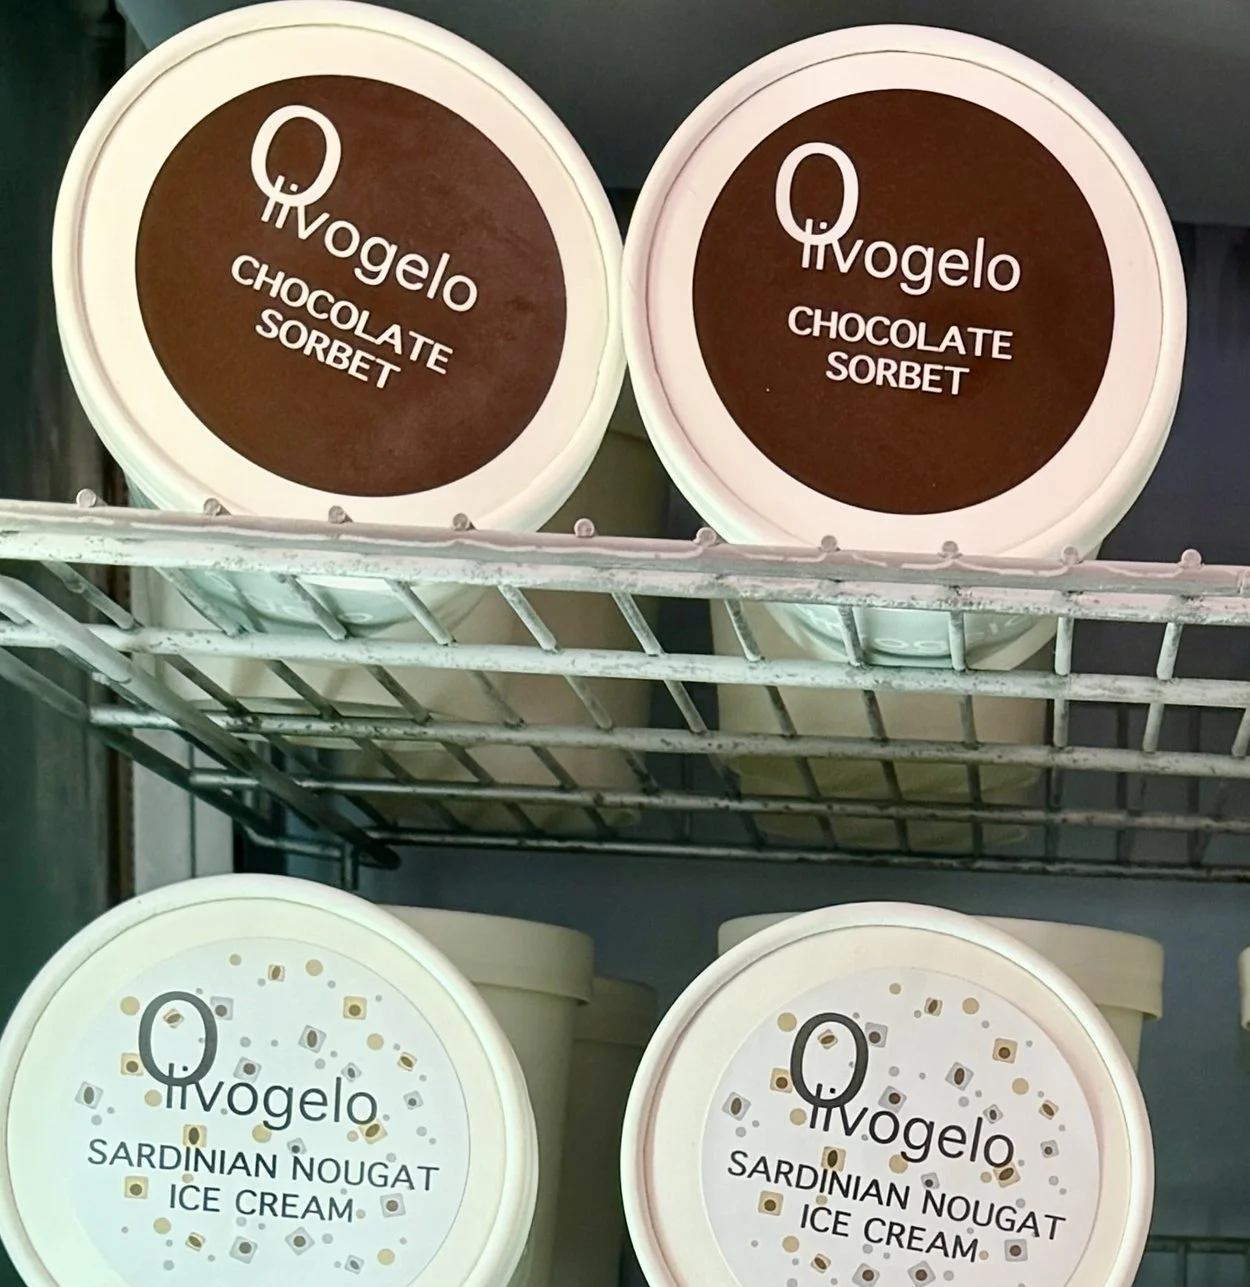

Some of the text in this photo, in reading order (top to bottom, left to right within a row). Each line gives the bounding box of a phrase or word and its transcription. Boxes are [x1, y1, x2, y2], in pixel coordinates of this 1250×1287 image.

[230, 255, 454, 376] CHOCOLATE
[787, 305, 1015, 360] CHOCOLATE
[254, 307, 401, 391] SORBET
[825, 351, 971, 396] SORBET
[87, 1138, 440, 1193] SARDINIAN NOUGAT
[168, 1185, 354, 1223] ICE CREAM
[728, 1149, 1066, 1241] SARDINIAN NOUGAT
[799, 1206, 980, 1262] ICE CREAM
